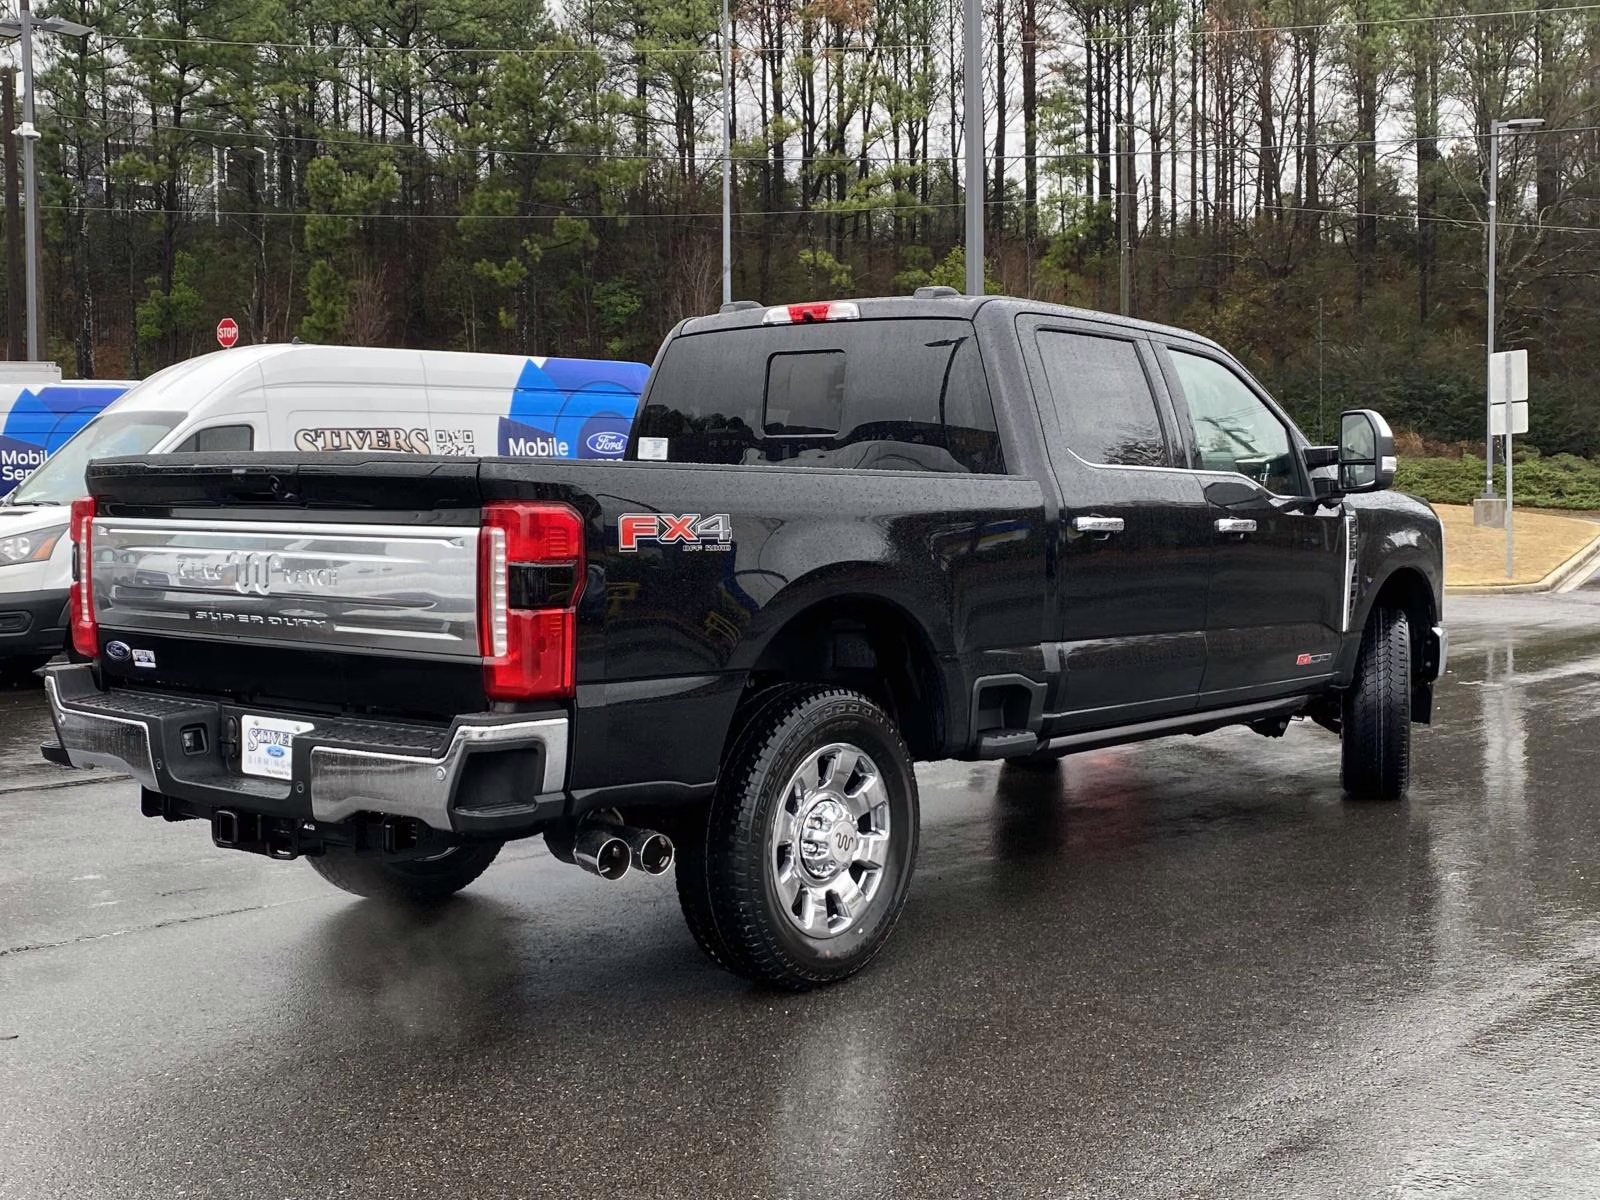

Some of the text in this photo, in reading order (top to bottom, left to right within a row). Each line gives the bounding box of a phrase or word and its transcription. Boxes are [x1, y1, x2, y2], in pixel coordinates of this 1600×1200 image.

[219, 327, 237, 338] STOP
[295, 428, 431, 455] STIVERS
[508, 438, 568, 456] Mobile
[595, 434, 624, 451] Ford
[618, 513, 732, 552] FX4
[282, 568, 338, 587] RANCH
[195, 611, 326, 628] SUPER DUTY
